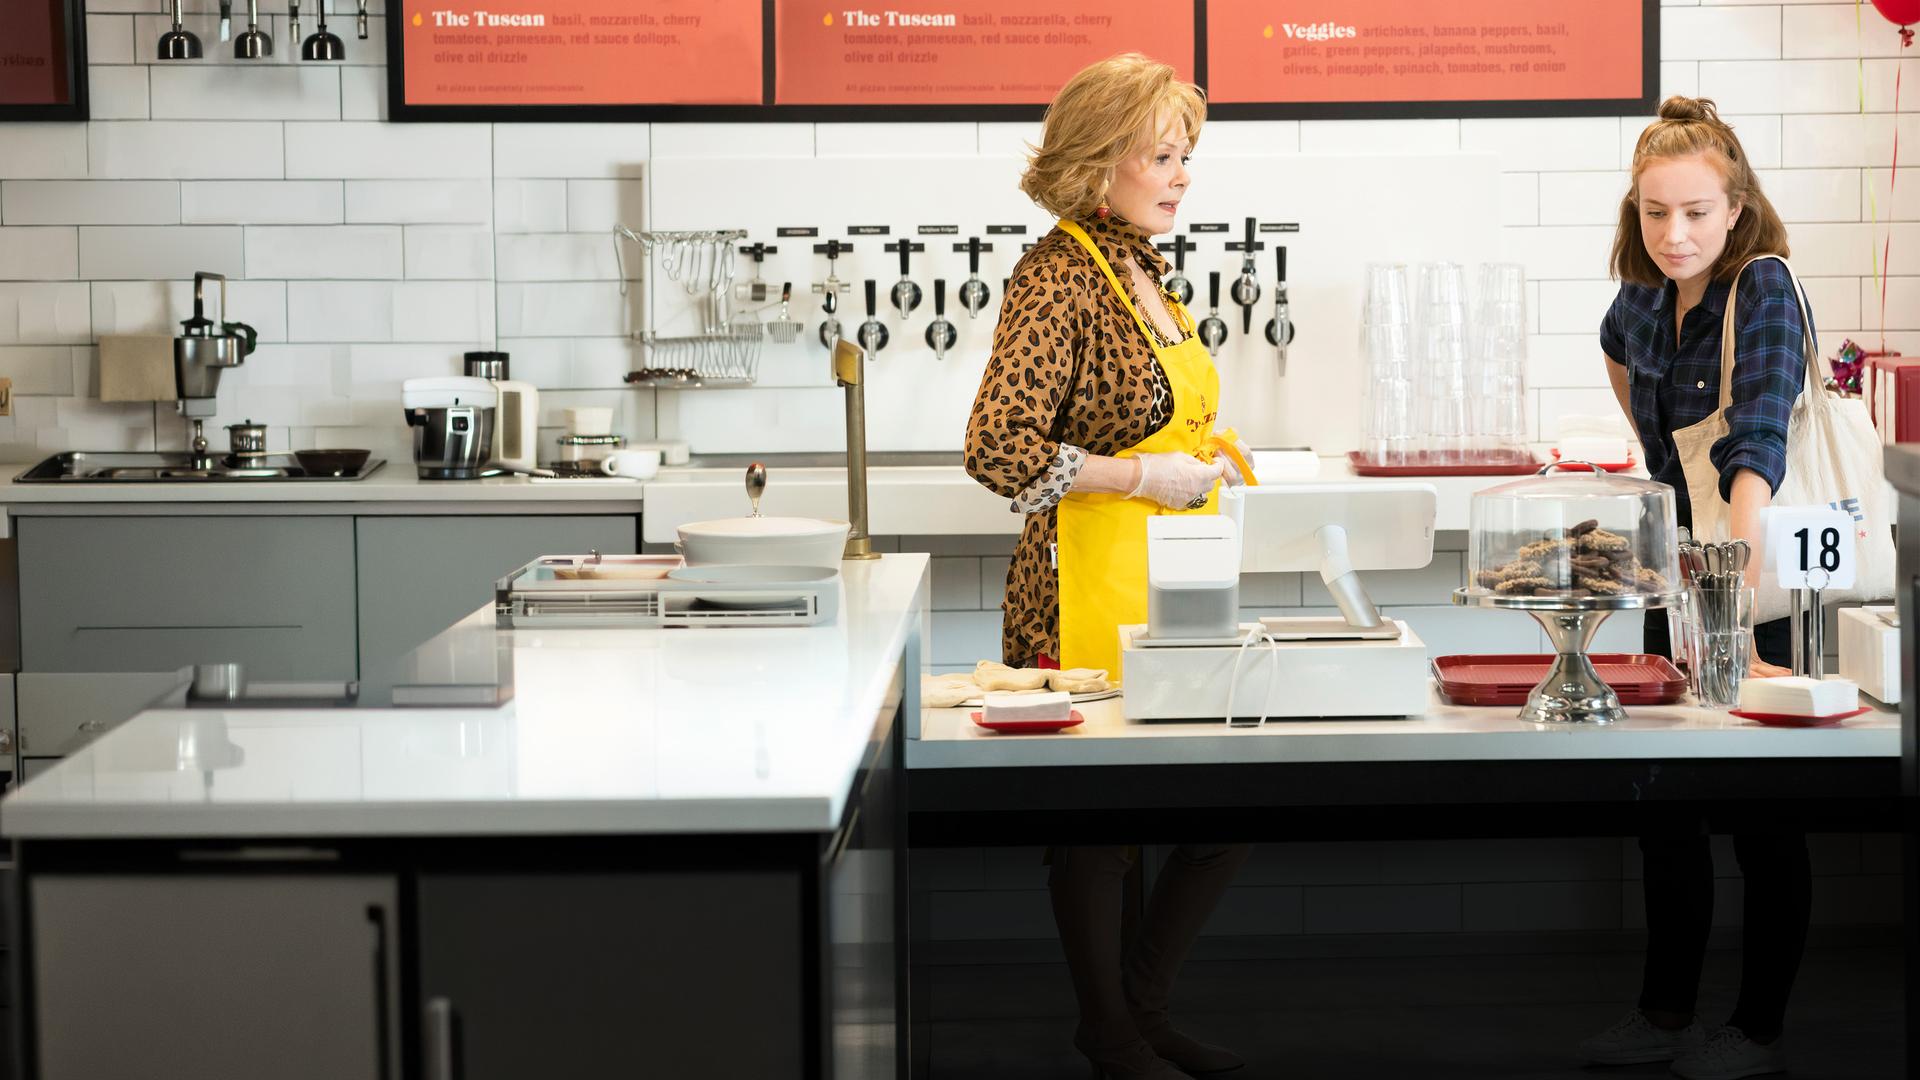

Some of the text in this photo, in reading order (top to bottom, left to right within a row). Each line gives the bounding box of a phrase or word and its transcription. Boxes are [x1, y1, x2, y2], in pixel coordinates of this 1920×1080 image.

[432, 10, 702, 29] The Tuscan basil, mozzarella, cherry
[843, 10, 1113, 28] The Tuscan basil, mozzarella, cherry
[433, 32, 682, 47] tomatoes, parmesean, red sauce dollops,
[843, 32, 1092, 47] tomatoes, parmesean, red sauce dollops,
[1282, 21, 1569, 42] Veggies artichokes, banana peppers, basil,
[433, 51, 528, 64] olive oil drizzle
[843, 51, 939, 64] olive oil drizzle
[1282, 43, 1557, 60] garlic, green peppers, jalapeños, mushrooms,
[1282, 61, 1567, 77] olives, pineapple, spinach, tomatoes, red onion
[1794, 527, 1840, 572] 18
